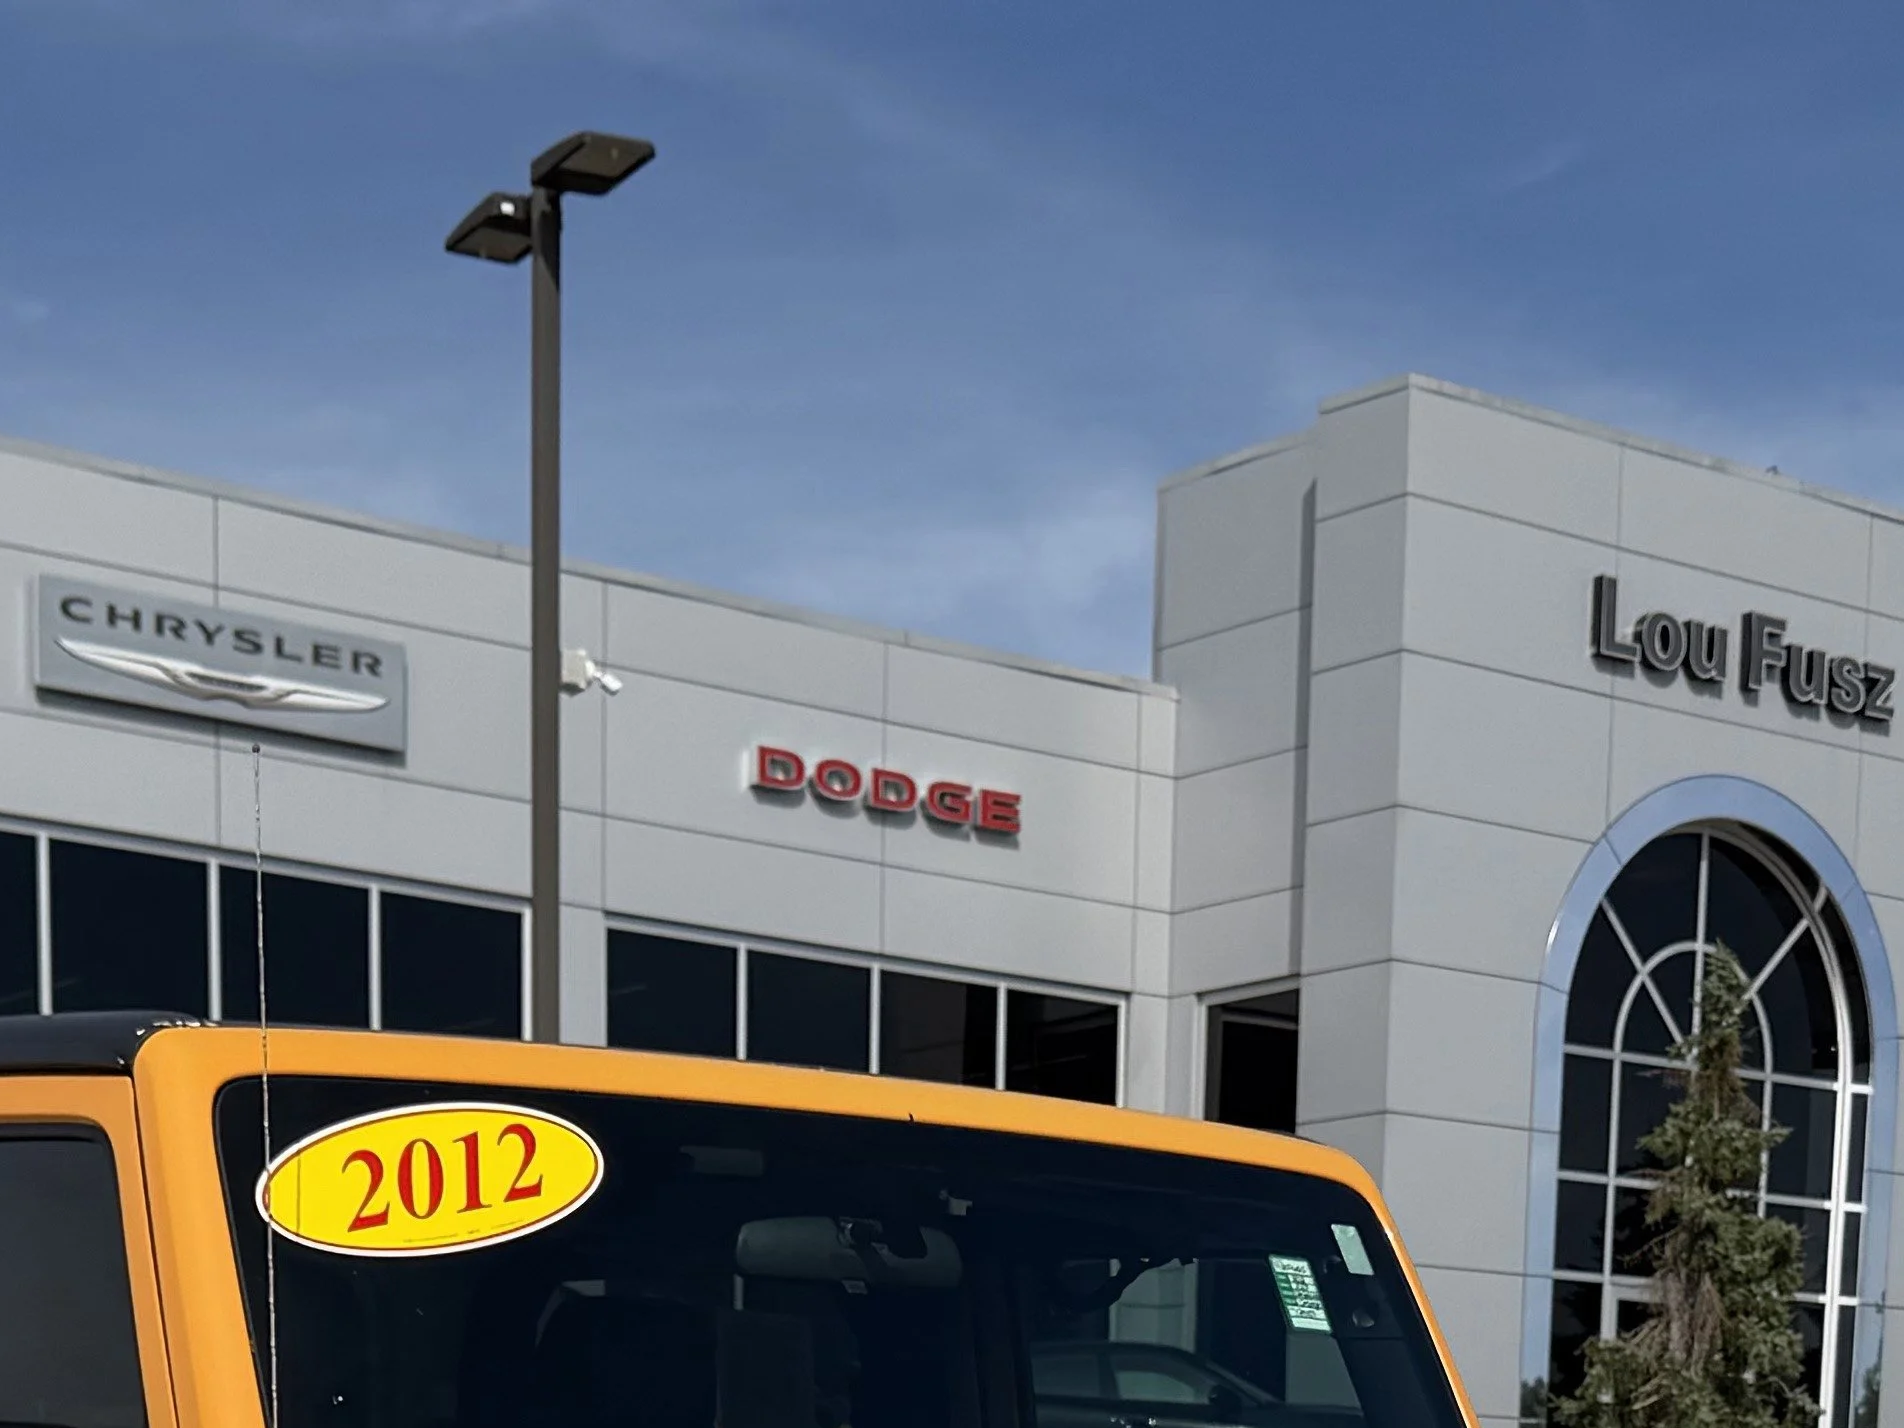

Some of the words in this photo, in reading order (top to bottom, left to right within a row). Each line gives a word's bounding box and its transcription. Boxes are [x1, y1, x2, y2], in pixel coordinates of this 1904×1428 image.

[59, 595, 384, 678] CHRYSLER
[1590, 574, 1729, 684] Lou
[1741, 610, 1896, 722] Fusz
[756, 745, 1022, 836] DODGE
[342, 1123, 544, 1233] 2012
